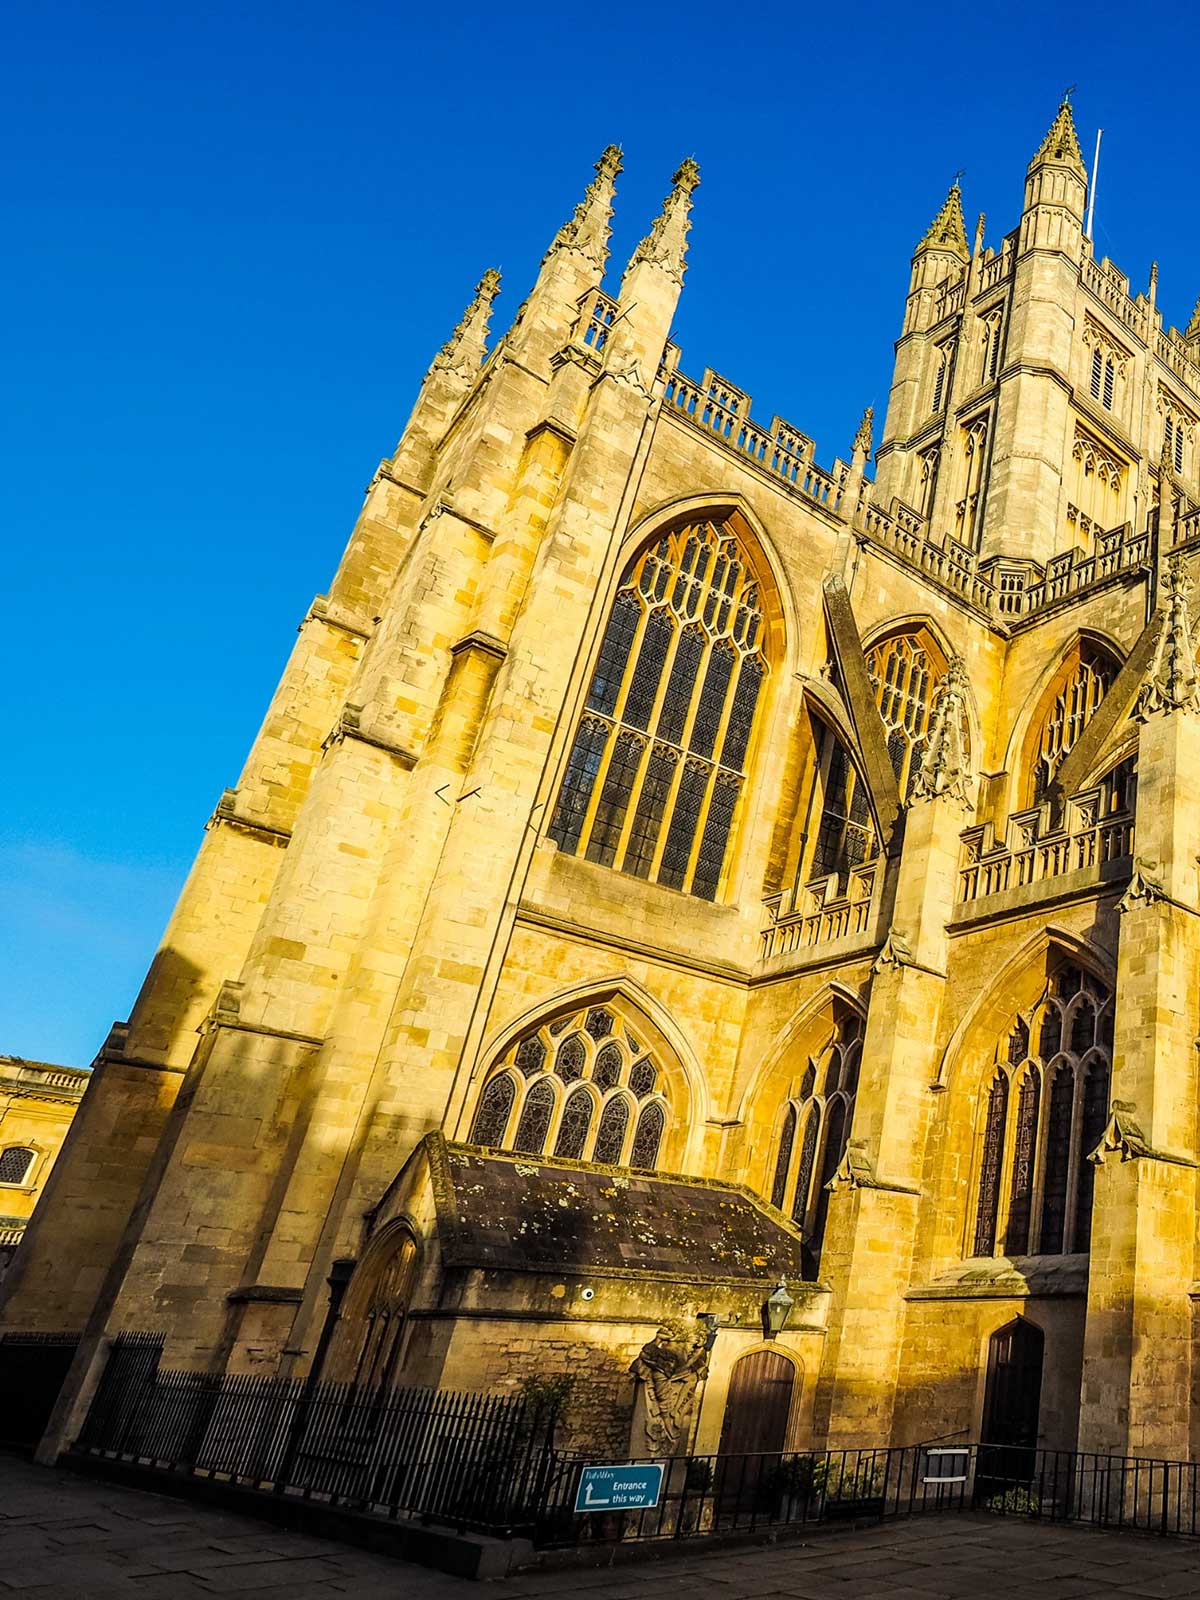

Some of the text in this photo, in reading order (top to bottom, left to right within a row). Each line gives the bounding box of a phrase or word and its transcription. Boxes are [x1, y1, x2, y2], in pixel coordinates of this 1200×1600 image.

[612, 1481, 647, 1491] Entrance
[612, 1494, 646, 1504] this way
